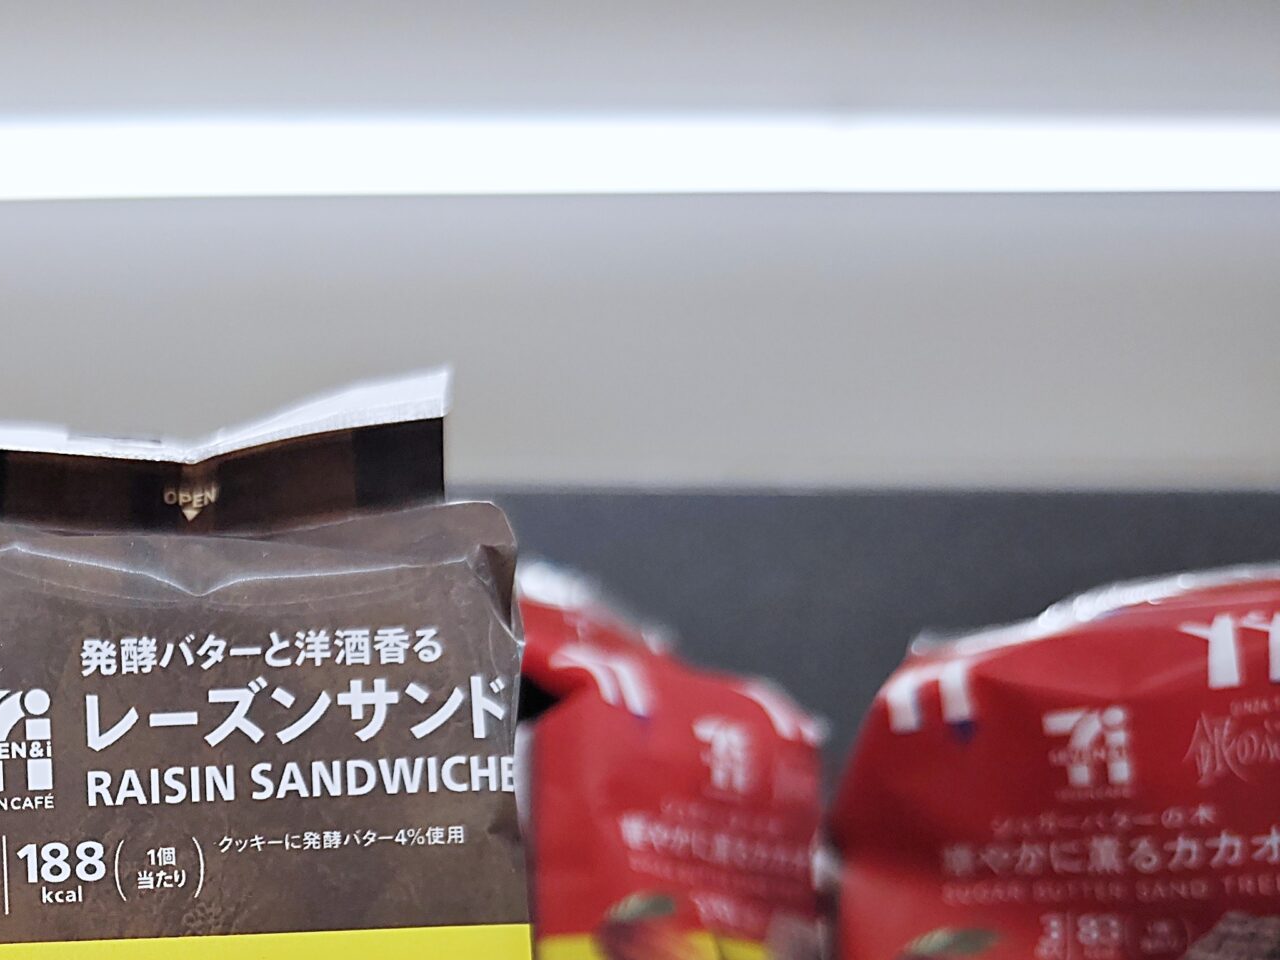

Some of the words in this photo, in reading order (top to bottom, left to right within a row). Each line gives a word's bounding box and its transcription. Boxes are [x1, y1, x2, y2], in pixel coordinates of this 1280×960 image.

[163, 485, 219, 510] OPEN
[80, 627, 444, 679] 発酵バターと洋酒香る
[84, 673, 507, 754] レーズンサンド
[86, 763, 236, 808] RAISIN
[15, 840, 107, 885] 188
[217, 824, 466, 856] クッキーに発酵バター4%使用
[41, 883, 85, 905] kcal
